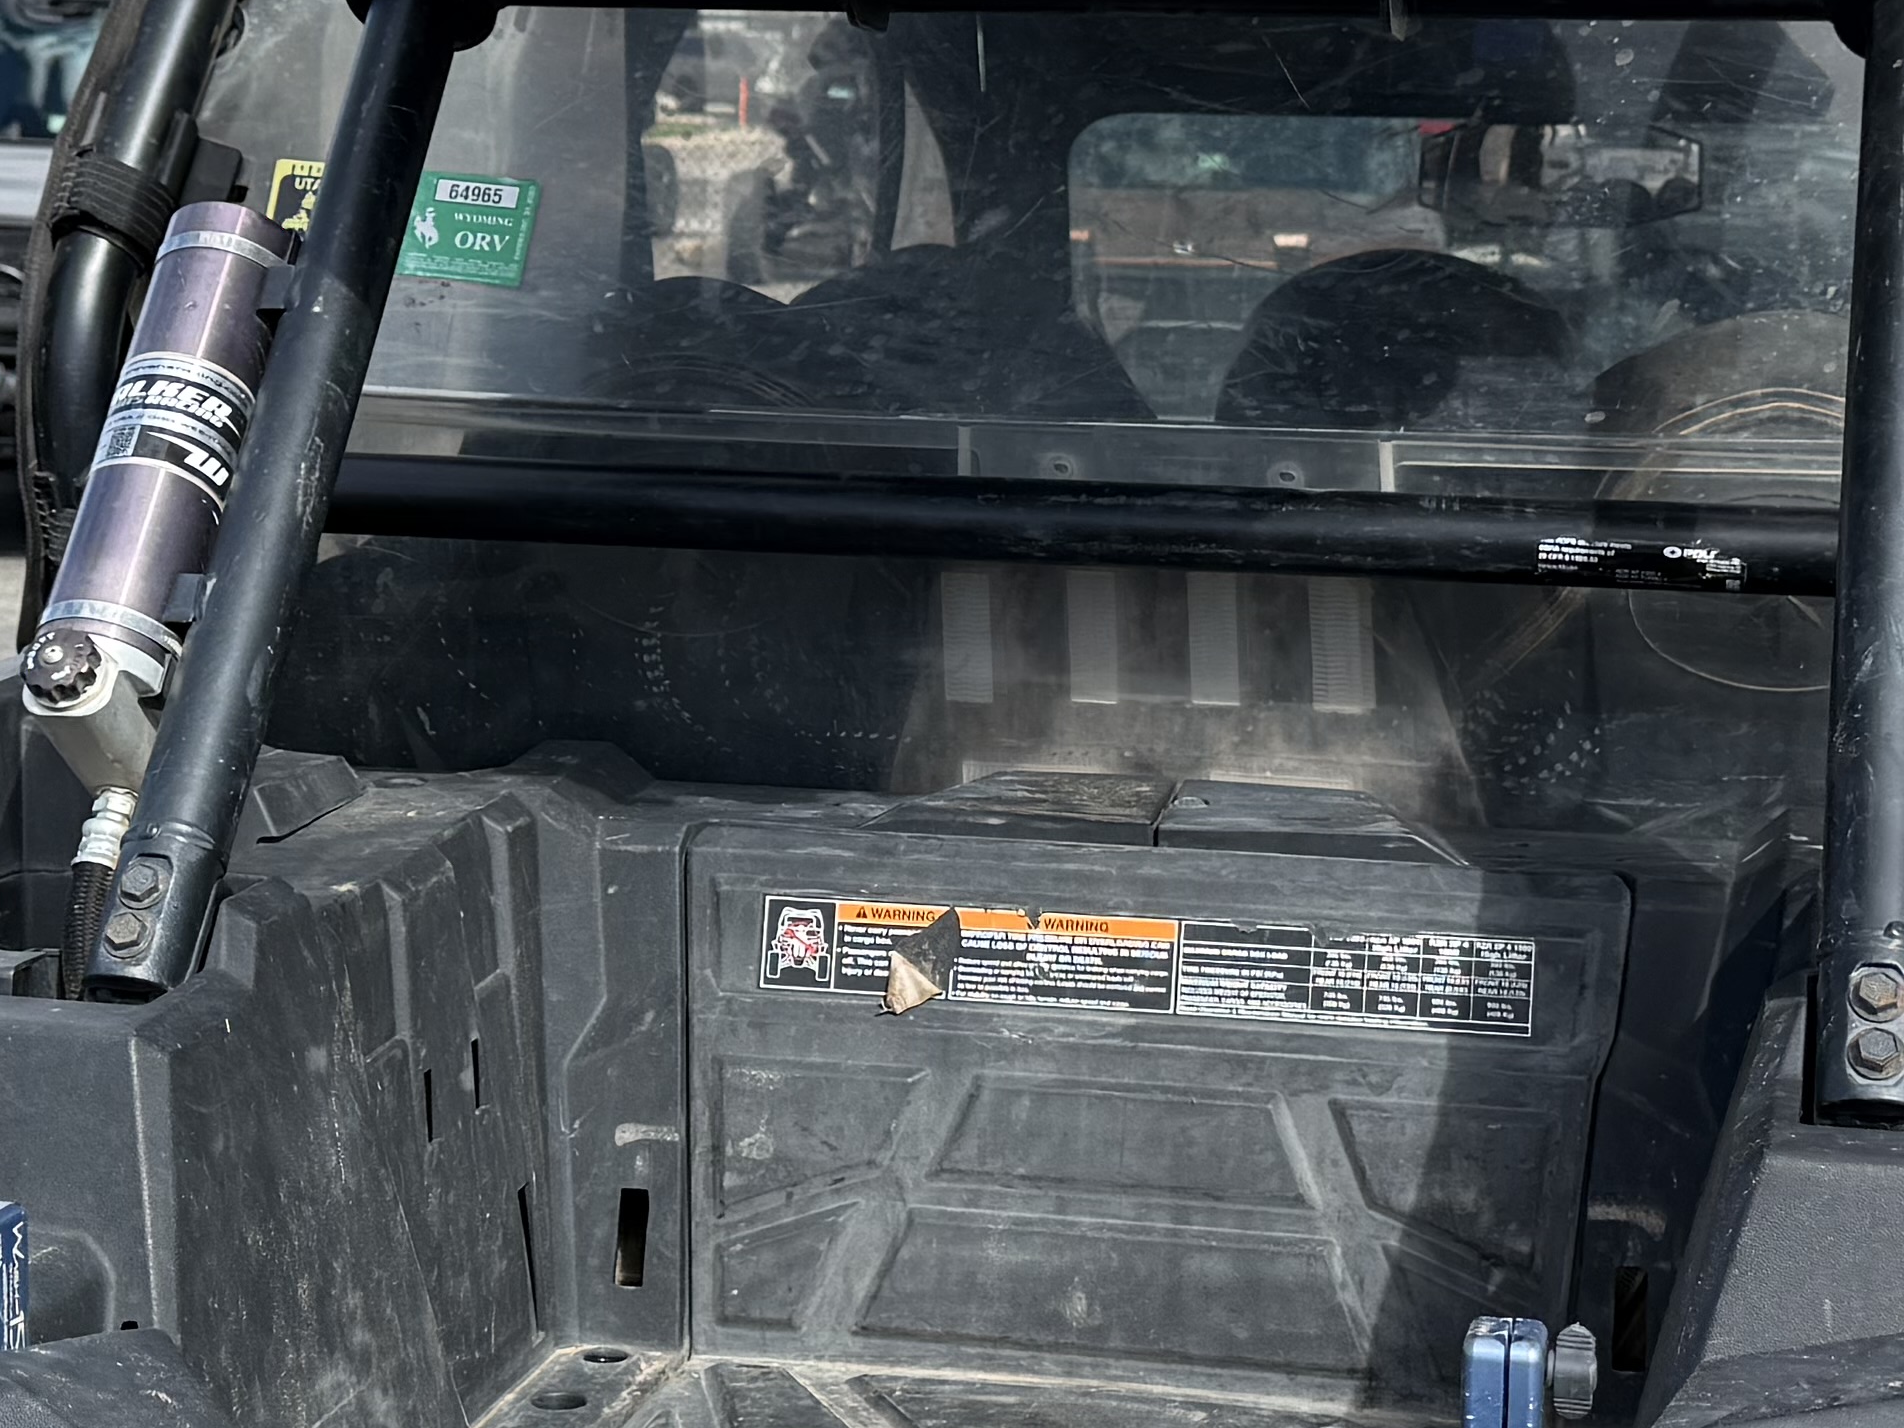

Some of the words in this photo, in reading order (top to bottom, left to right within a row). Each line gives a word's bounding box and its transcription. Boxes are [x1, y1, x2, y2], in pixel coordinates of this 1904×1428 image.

[448, 183, 504, 204] 64965
[454, 212, 514, 227] WYOMING
[454, 230, 510, 252] ORV
[116, 379, 233, 419] ALKER
[871, 907, 936, 922] WARNING
[1043, 917, 1110, 933] WARNING
